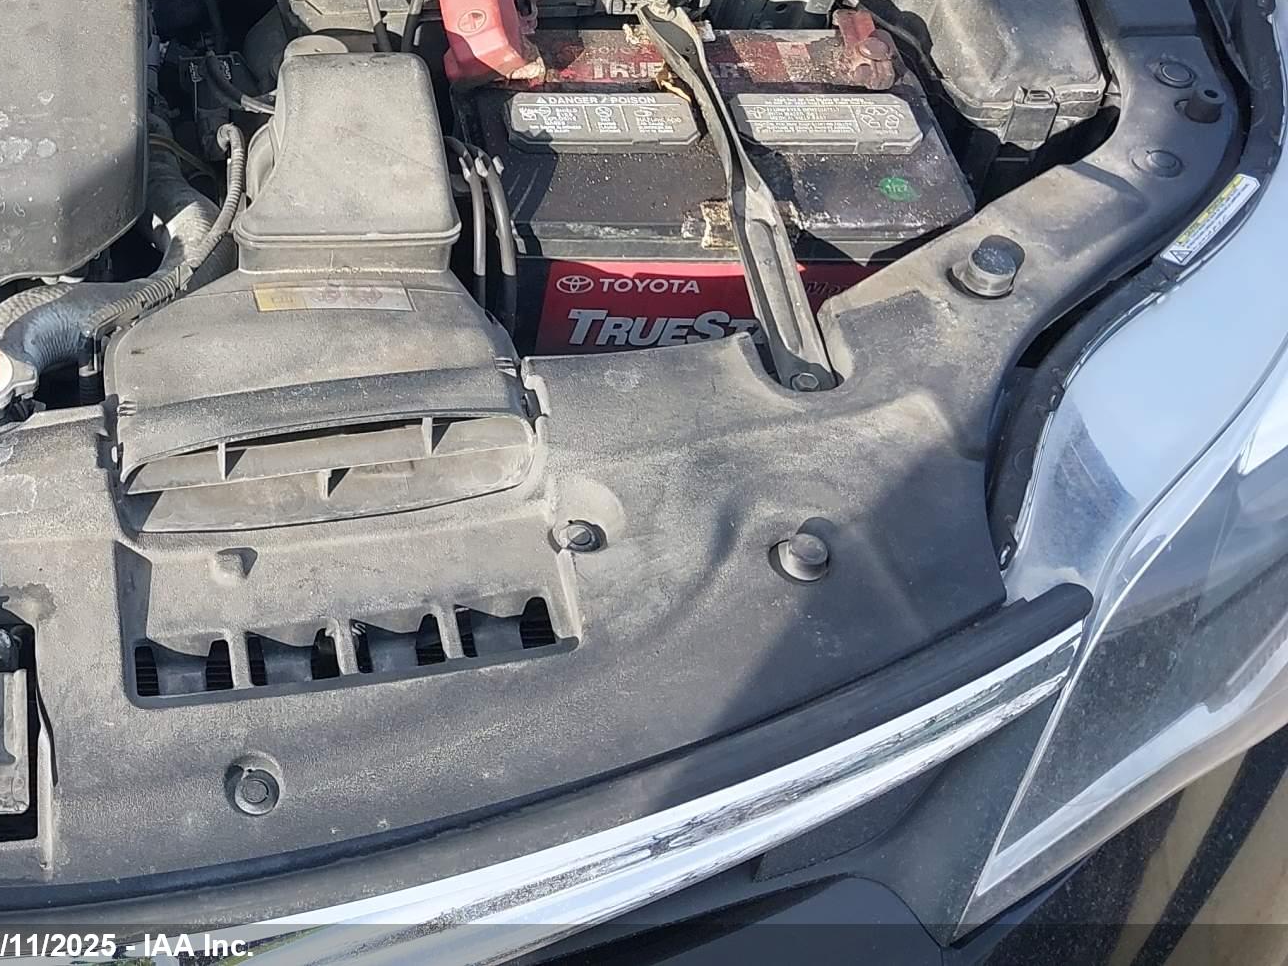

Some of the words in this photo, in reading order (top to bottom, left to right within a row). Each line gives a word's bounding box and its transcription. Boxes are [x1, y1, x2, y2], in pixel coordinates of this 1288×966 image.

[548, 96, 598, 104] DANGER
[610, 96, 657, 104] POISON
[599, 278, 700, 294] TOYOTA
